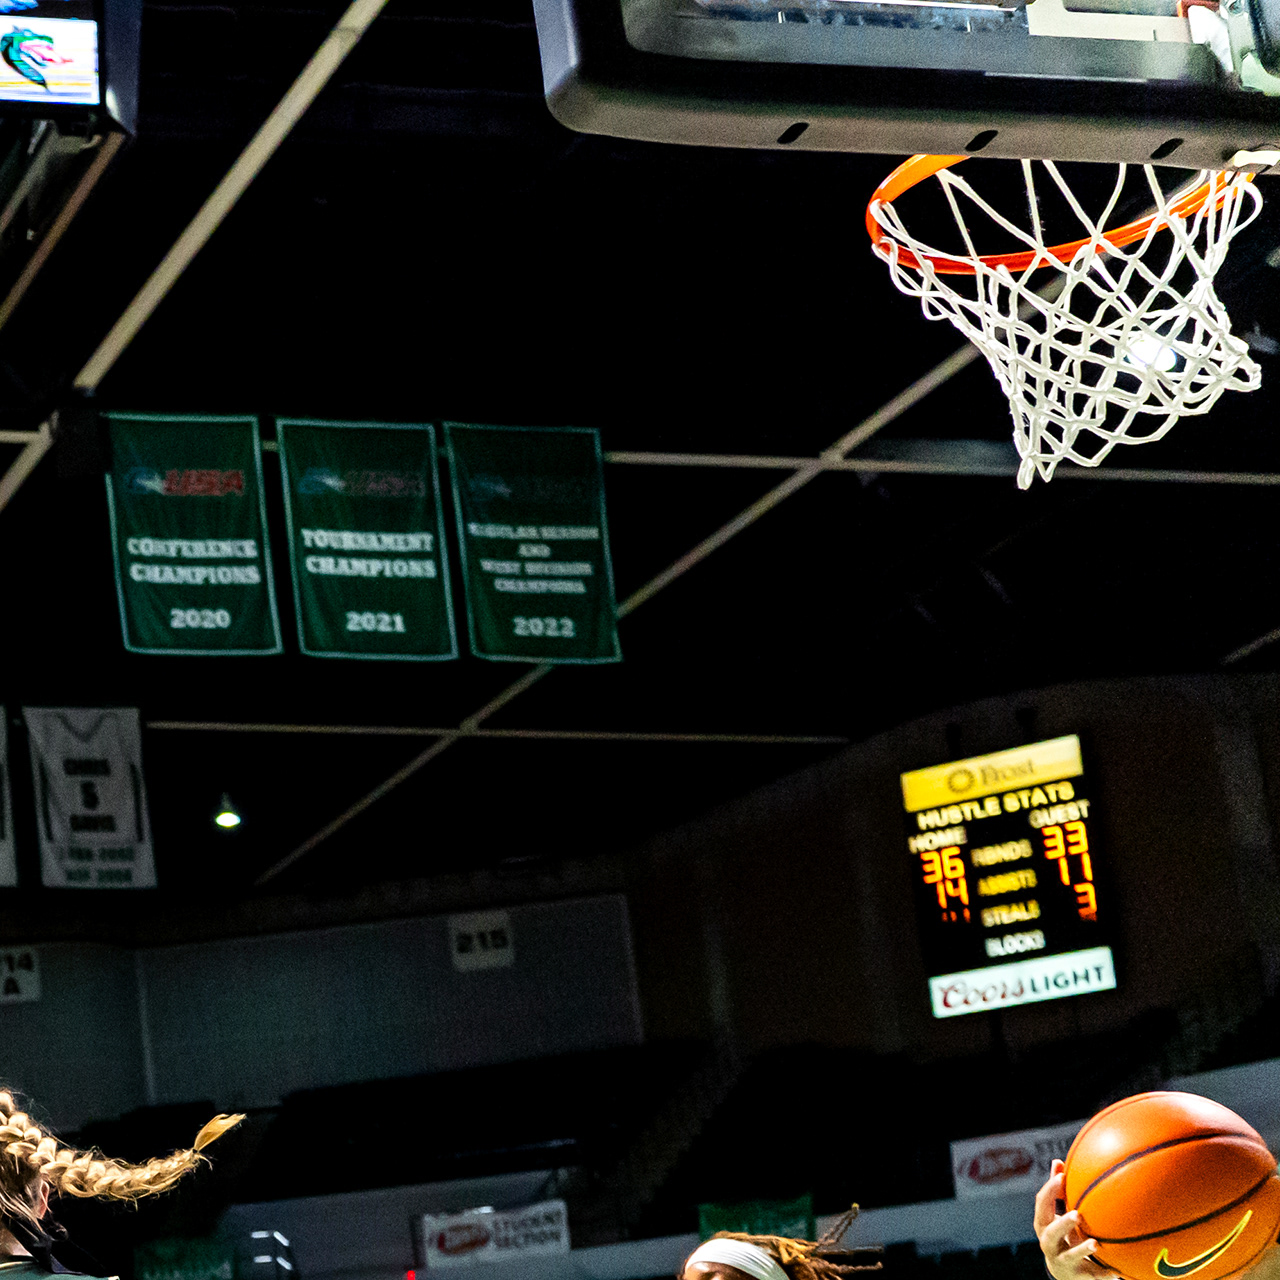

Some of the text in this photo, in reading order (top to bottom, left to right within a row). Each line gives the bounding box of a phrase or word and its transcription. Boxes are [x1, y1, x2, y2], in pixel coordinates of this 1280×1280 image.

[127, 538, 257, 557] CONFERENCE
[301, 528, 433, 551] TOURNAMENT
[130, 564, 260, 584] CHAMPIONS
[305, 556, 436, 578] CHAMPIONS
[170, 609, 231, 628] 2020
[346, 612, 405, 632] 2021
[513, 616, 575, 637] 2022
[917, 781, 1075, 831] HUSTLE STATS
[908, 798, 1090, 855] HOME GUEST
[920, 846, 965, 884] 36
[1041, 820, 1089, 860] 33
[1030, 965, 1106, 994] LIGHT
